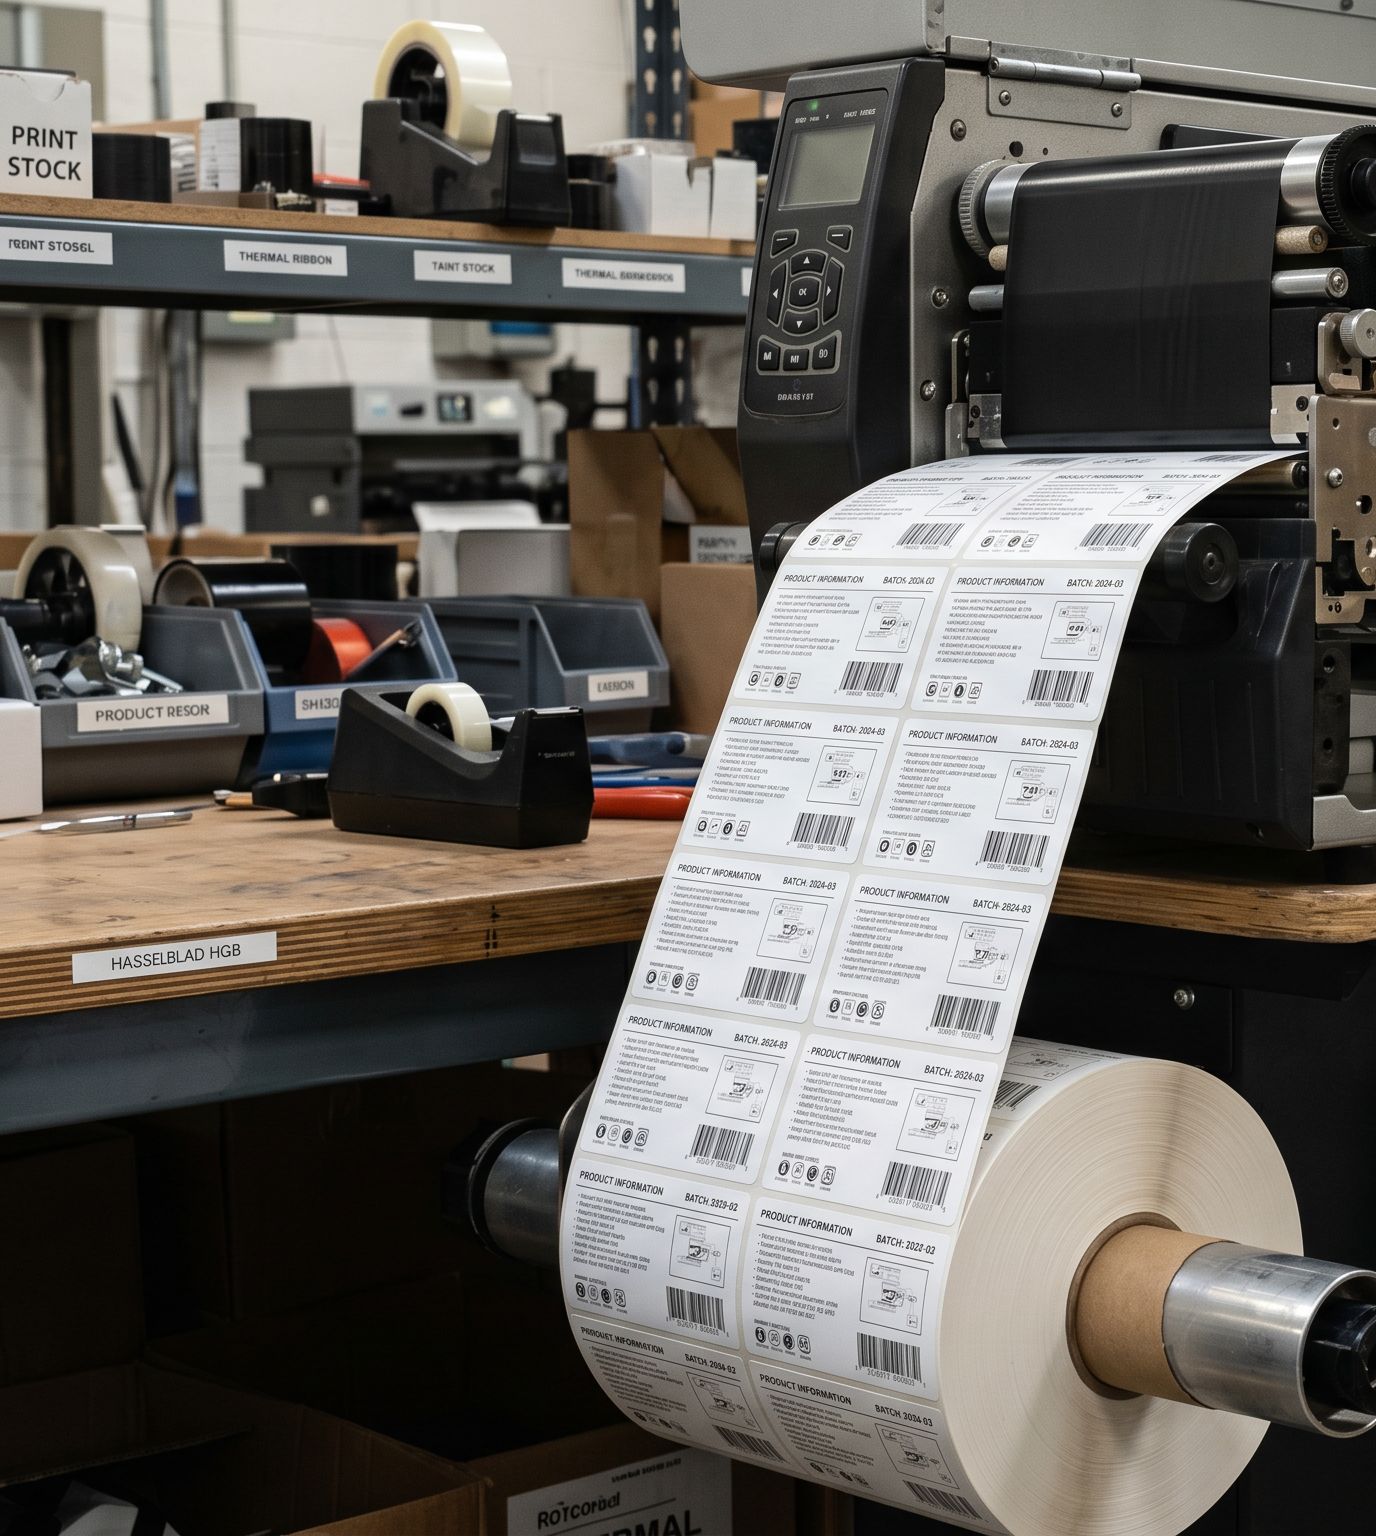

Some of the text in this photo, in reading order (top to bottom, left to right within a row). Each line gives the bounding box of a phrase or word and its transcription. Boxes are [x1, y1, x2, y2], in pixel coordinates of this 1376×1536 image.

[12, 125, 78, 150] PRINT
[8, 156, 82, 181] STOCK
[239, 251, 333, 265] THERMAL RIBBON
[462, 262, 495, 273] STOCK
[957, 577, 992, 586] PRODUCT
[95, 704, 210, 722] PRODUCT RESOR
[729, 717, 812, 731] PRODUCT INFORMATION
[908, 730, 998, 744] PRODUCT INFORMATION
[677, 864, 711, 876] PRODUCT
[896, 888, 950, 904] INFORMATION
[111, 943, 242, 971] HASSELBLAD HGB
[628, 1015, 662, 1028] PRODUCT
[811, 1047, 901, 1069] PRODUCT INFORMATION
[924, 1065, 953, 1079] BATCH:
[614, 1176, 665, 1196] INFORMATION
[760, 1209, 853, 1237] PRODUCT INFORMATION
[876, 1234, 905, 1249] BATCH:
